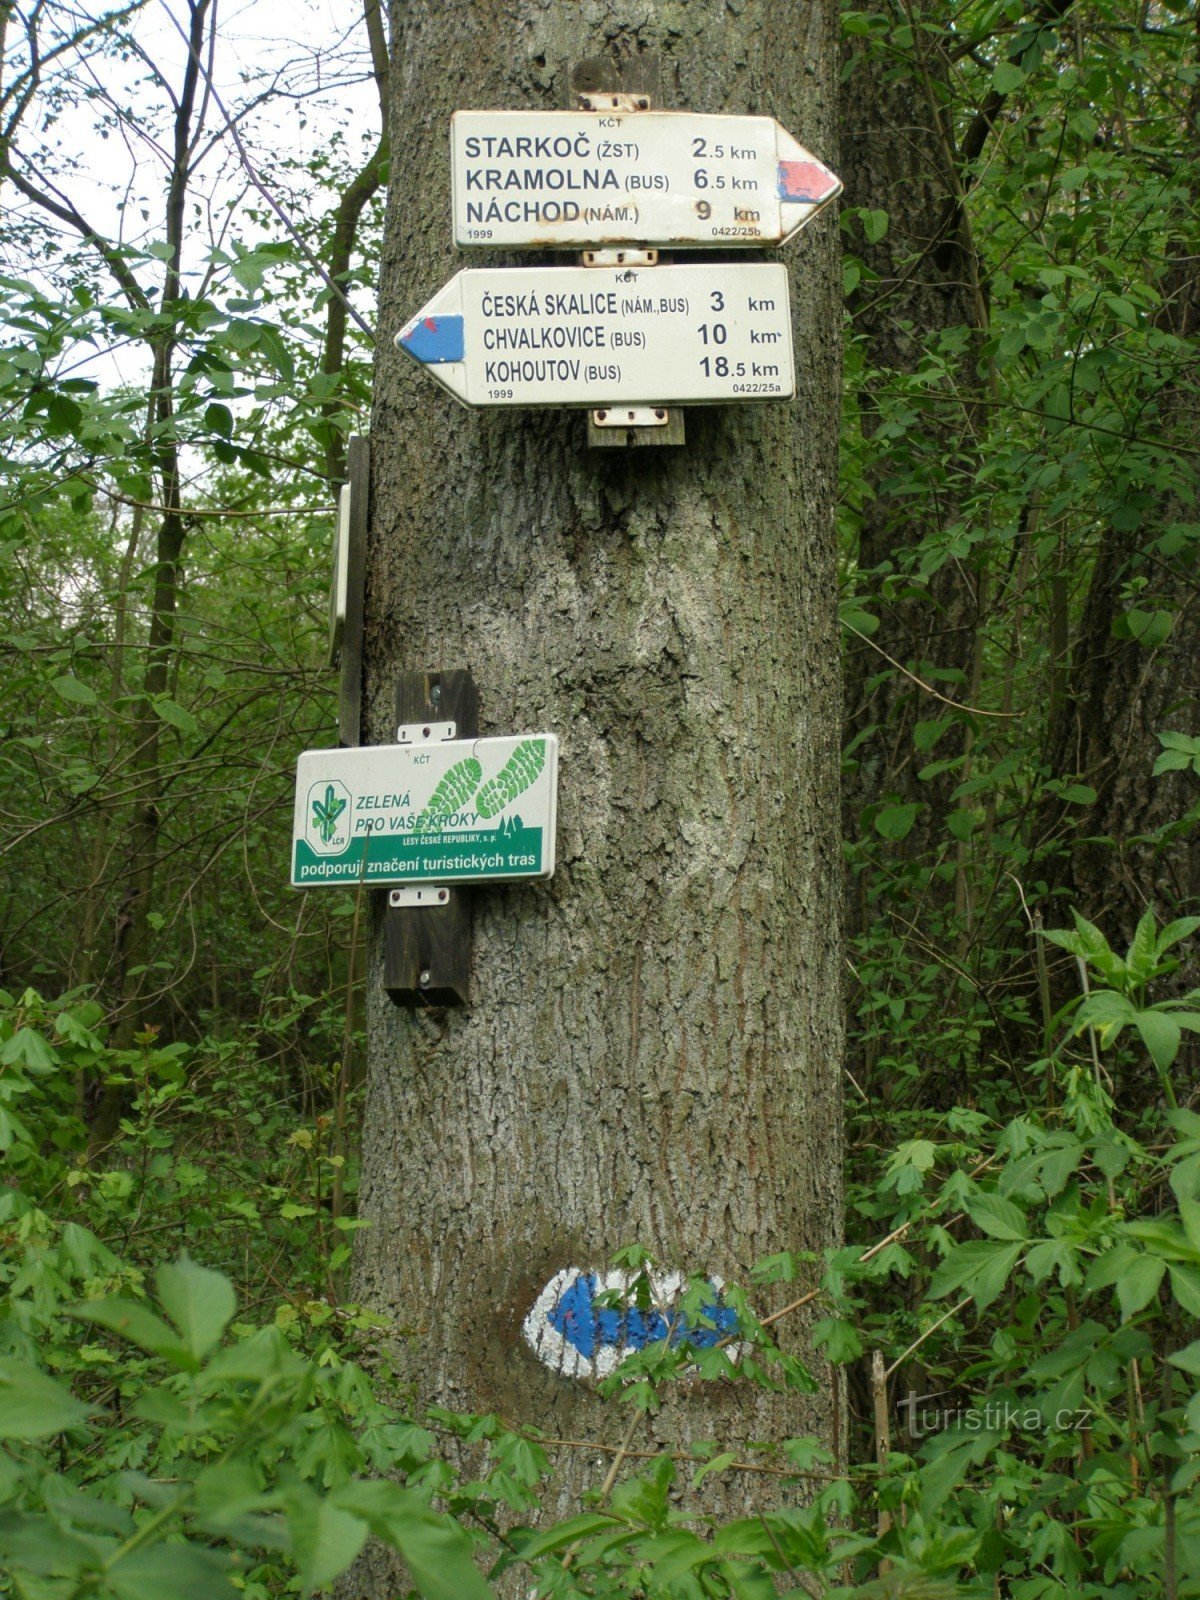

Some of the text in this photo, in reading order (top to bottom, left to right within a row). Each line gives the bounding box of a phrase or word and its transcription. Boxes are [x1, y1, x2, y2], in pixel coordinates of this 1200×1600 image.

[599, 118, 622, 128] KČT
[465, 132, 757, 160] STARKOČ (ŽST) 2.5 km
[466, 169, 758, 192] KRAMOLNA (BUS) 6.5 km
[466, 197, 760, 224] NÁCHOD (NÁM.) 9 km
[467, 227, 761, 238] 1999 0422/25b
[482, 290, 540, 317] ČESKÁ
[545, 293, 617, 315] SKALICE
[710, 291, 725, 312] 3
[748, 297, 775, 311] km
[483, 324, 777, 350] CHVALKOVICE (BUS) 10 km
[485, 356, 779, 383] KOHOUTOV (BUS) 18.5 km
[488, 384, 781, 398] 1999 0422/25a
[414, 754, 430, 764] KČT
[356, 790, 410, 809] ZELENÁ
[355, 812, 480, 832] PRO VAŠE KROKY
[403, 837, 418, 846] LESY
[420, 835, 441, 844] ČESKÉ
[443, 835, 481, 844] REPUBLIKY,
[367, 857, 418, 873] značení
[423, 853, 503, 870] turistických
[508, 854, 536, 866] tras
